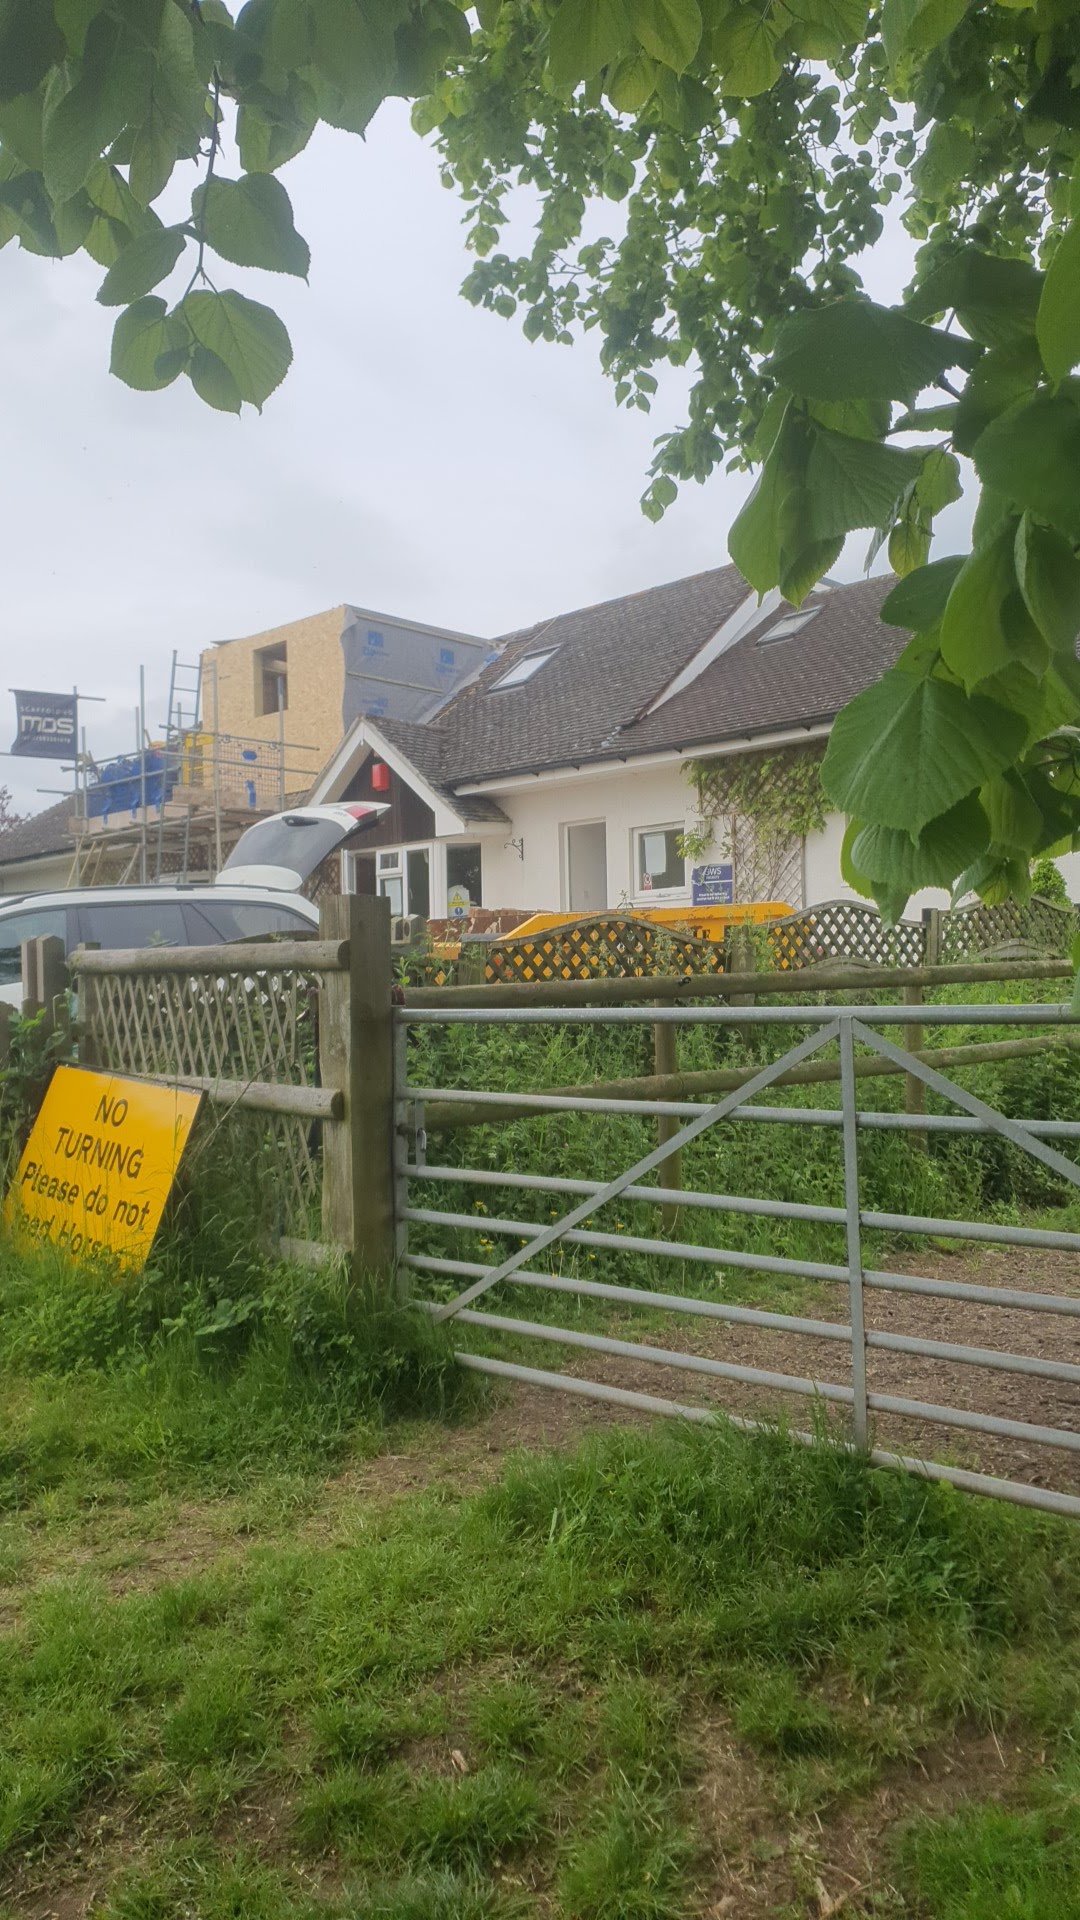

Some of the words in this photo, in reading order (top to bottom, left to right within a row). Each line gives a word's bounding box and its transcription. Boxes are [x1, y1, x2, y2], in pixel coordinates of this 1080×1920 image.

[20, 706, 74, 716] SCAFFOLDNG
[94, 1094, 129, 1128] NO
[54, 1127, 145, 1179] TURNING
[21, 1161, 81, 1205] Please
[85, 1184, 109, 1216] do
[112, 1200, 150, 1231] not
